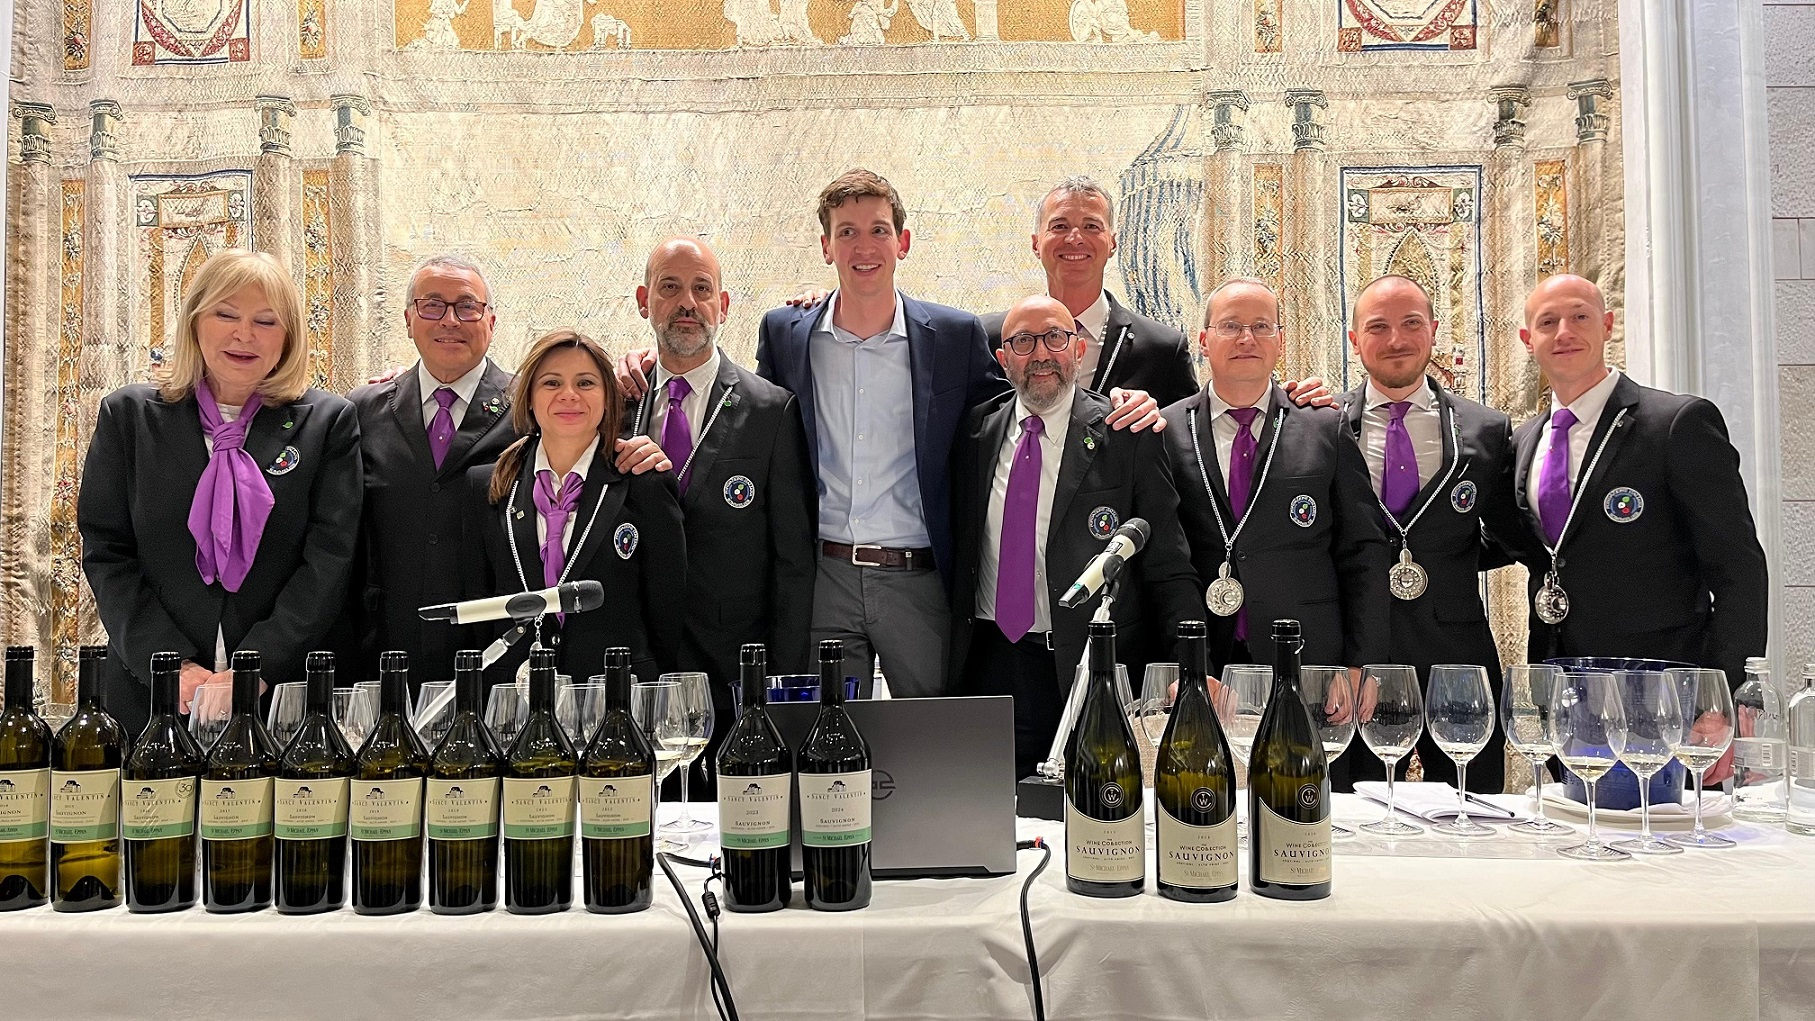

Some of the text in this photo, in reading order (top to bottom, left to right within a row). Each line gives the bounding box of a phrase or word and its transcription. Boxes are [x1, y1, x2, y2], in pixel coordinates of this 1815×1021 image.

[179, 784, 192, 792] 30
[1076, 846, 1141, 856] SAUVIGNON
[1168, 851, 1235, 861] SAUVIGNON
[1274, 847, 1331, 858] SAUVIGNO
